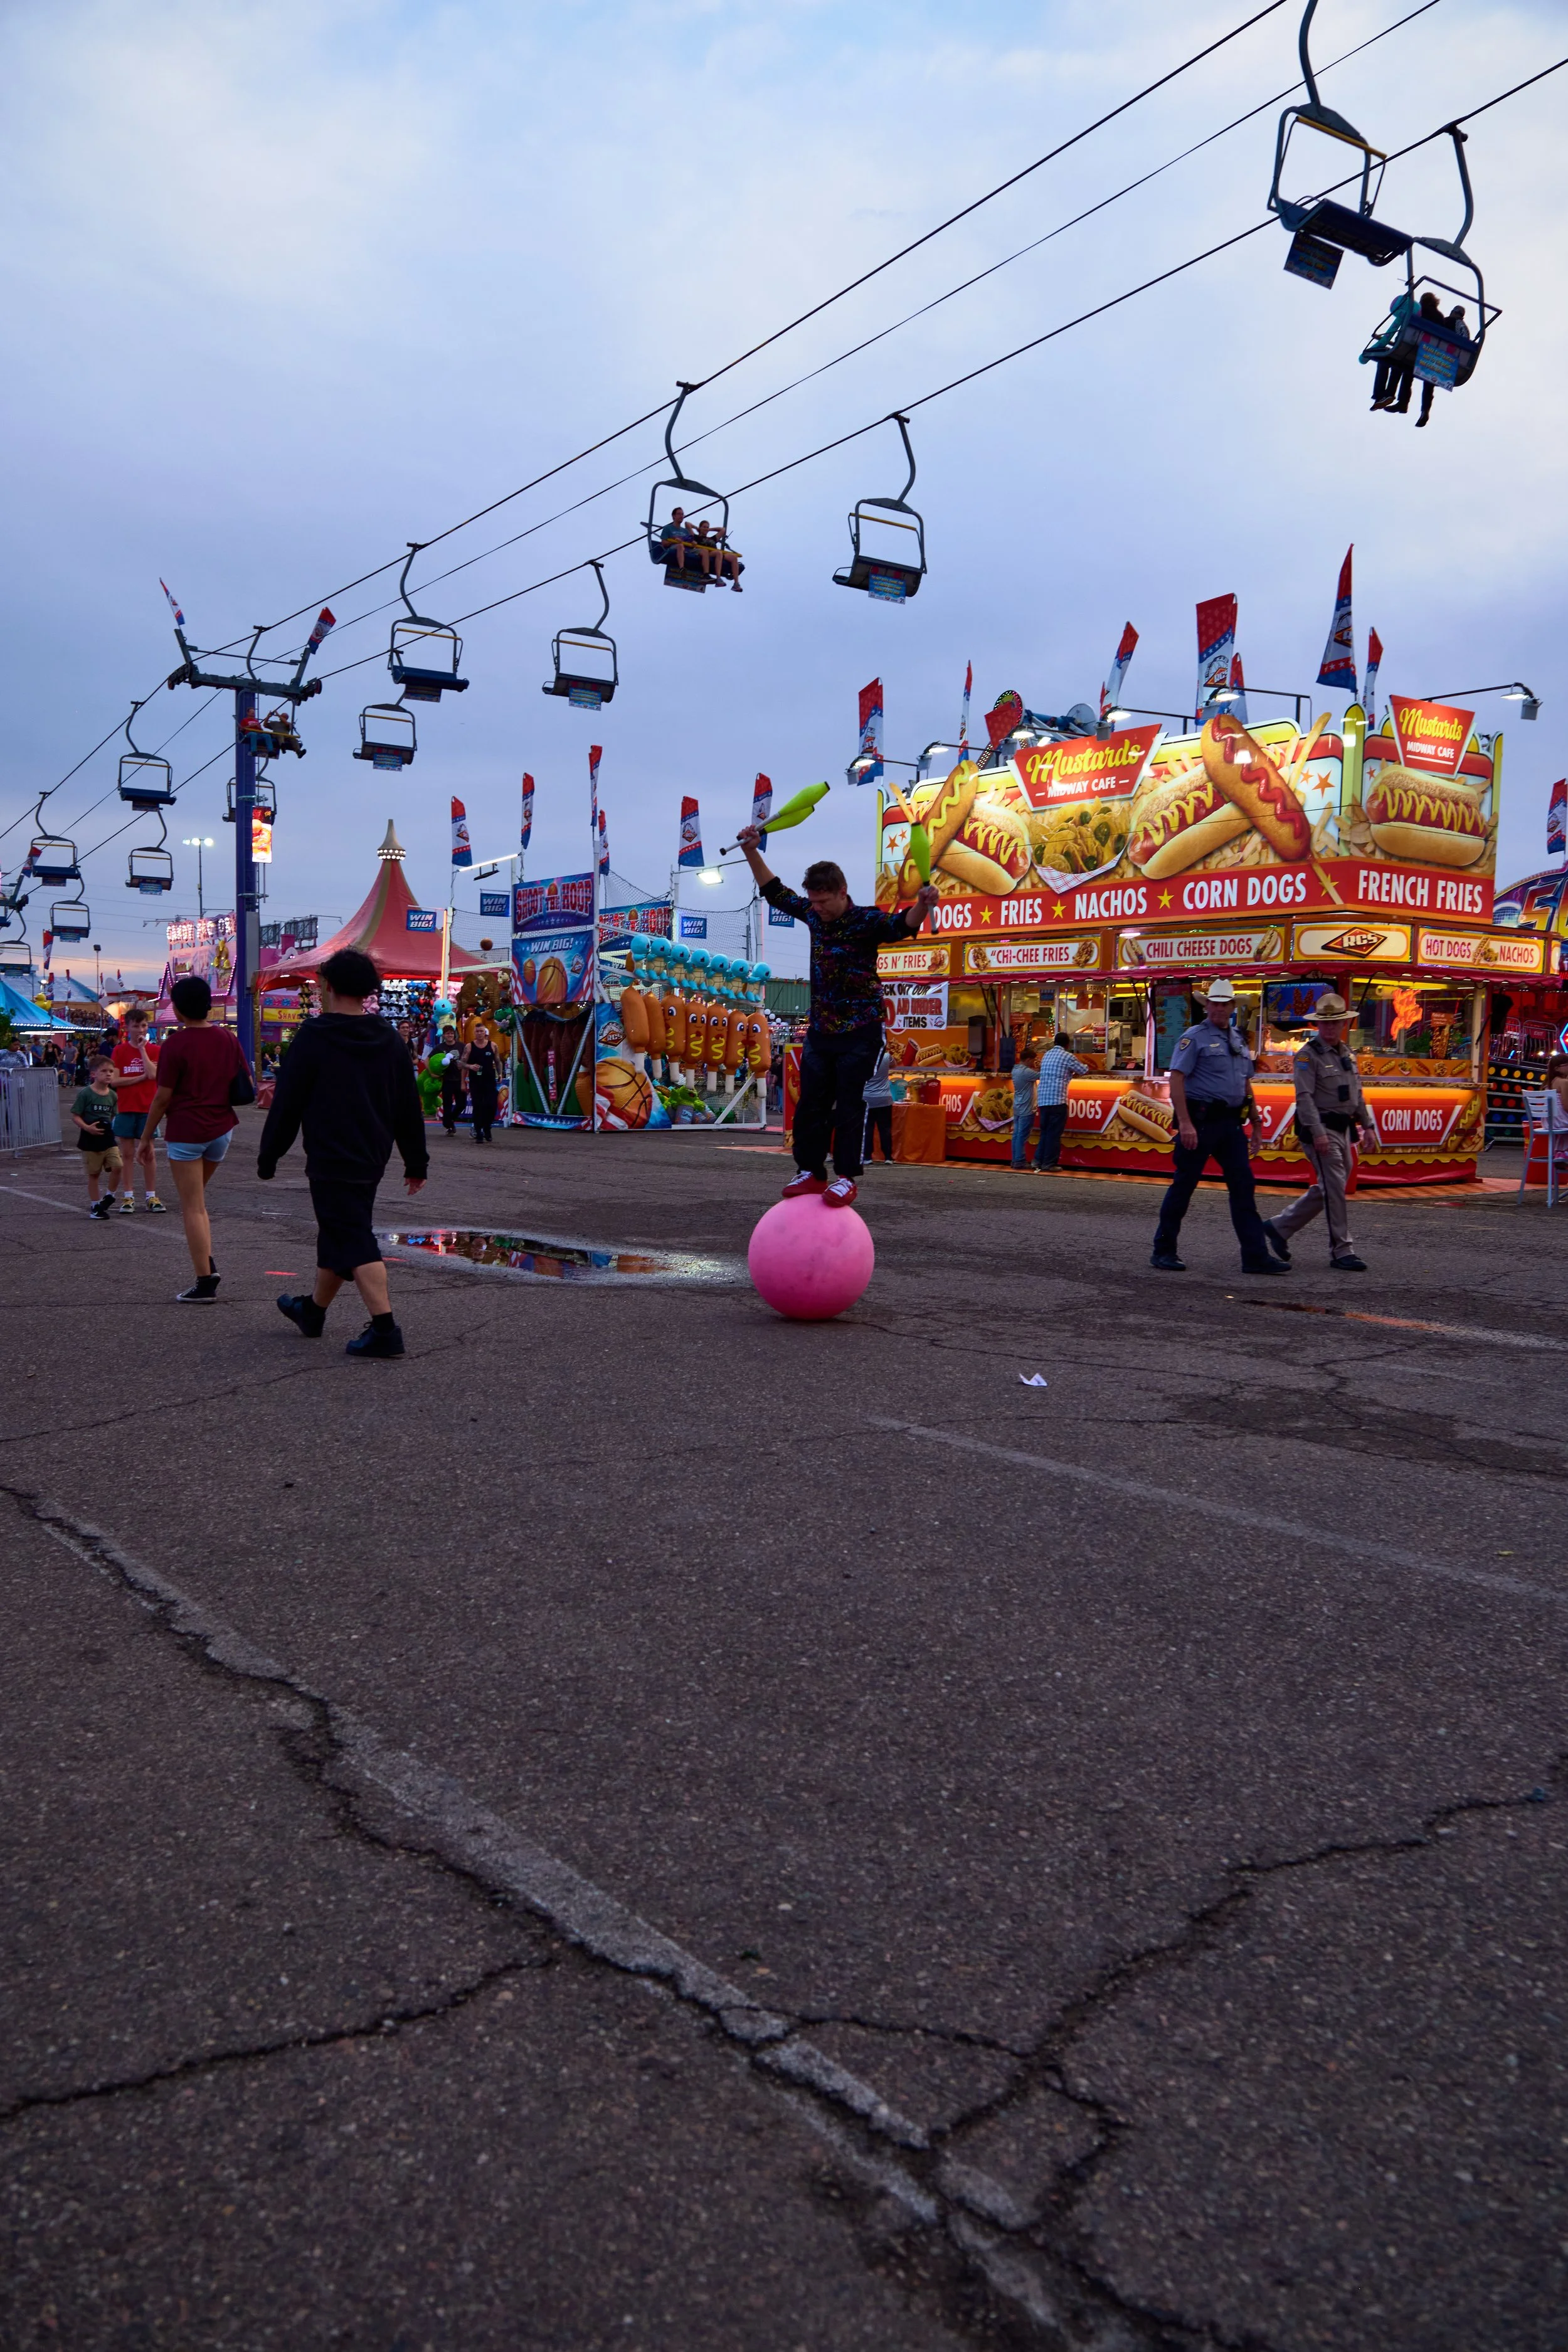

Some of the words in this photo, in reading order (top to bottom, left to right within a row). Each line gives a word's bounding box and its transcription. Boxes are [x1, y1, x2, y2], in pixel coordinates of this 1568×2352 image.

[1399, 707, 1463, 741] Mustards
[1406, 741, 1436, 756] MIDWAY
[1437, 746, 1454, 758] CAFE
[1025, 739, 1142, 784] Mustards
[1091, 776, 1116, 792] CAFE
[561, 879, 593, 916] HOOP
[933, 903, 972, 929] DOGS
[1000, 898, 1042, 925] FRIES
[1074, 887, 1147, 920] NACHOS
[1183, 878, 1238, 910] CORN
[1247, 872, 1306, 906] DOGS
[1358, 869, 1429, 907] FRENCH
[1436, 876, 1483, 914] FRIES
[484, 904, 506, 913] BIG!
[684, 926, 703, 935] BIG!
[531, 940, 551, 953] WIN
[551, 938, 574, 951] BIG!
[1147, 941, 1173, 958] CHILI
[1177, 940, 1216, 957] CHEESE
[1219, 938, 1252, 955] DOGS
[1343, 933, 1378, 948] RCS
[1426, 938, 1444, 956] HOT
[1446, 940, 1471, 959] DOGS
[877, 956, 888, 970] GS
[903, 954, 926, 968] FRIES
[1043, 946, 1069, 962] FRIES
[1499, 945, 1534, 963] NACHOS
[903, 1016, 927, 1028] ITEMS
[941, 1094, 962, 1113] CHOS
[1069, 1099, 1102, 1120] DOGS
[1382, 1110, 1411, 1131] CORN
[1414, 1110, 1443, 1131] DOGS
